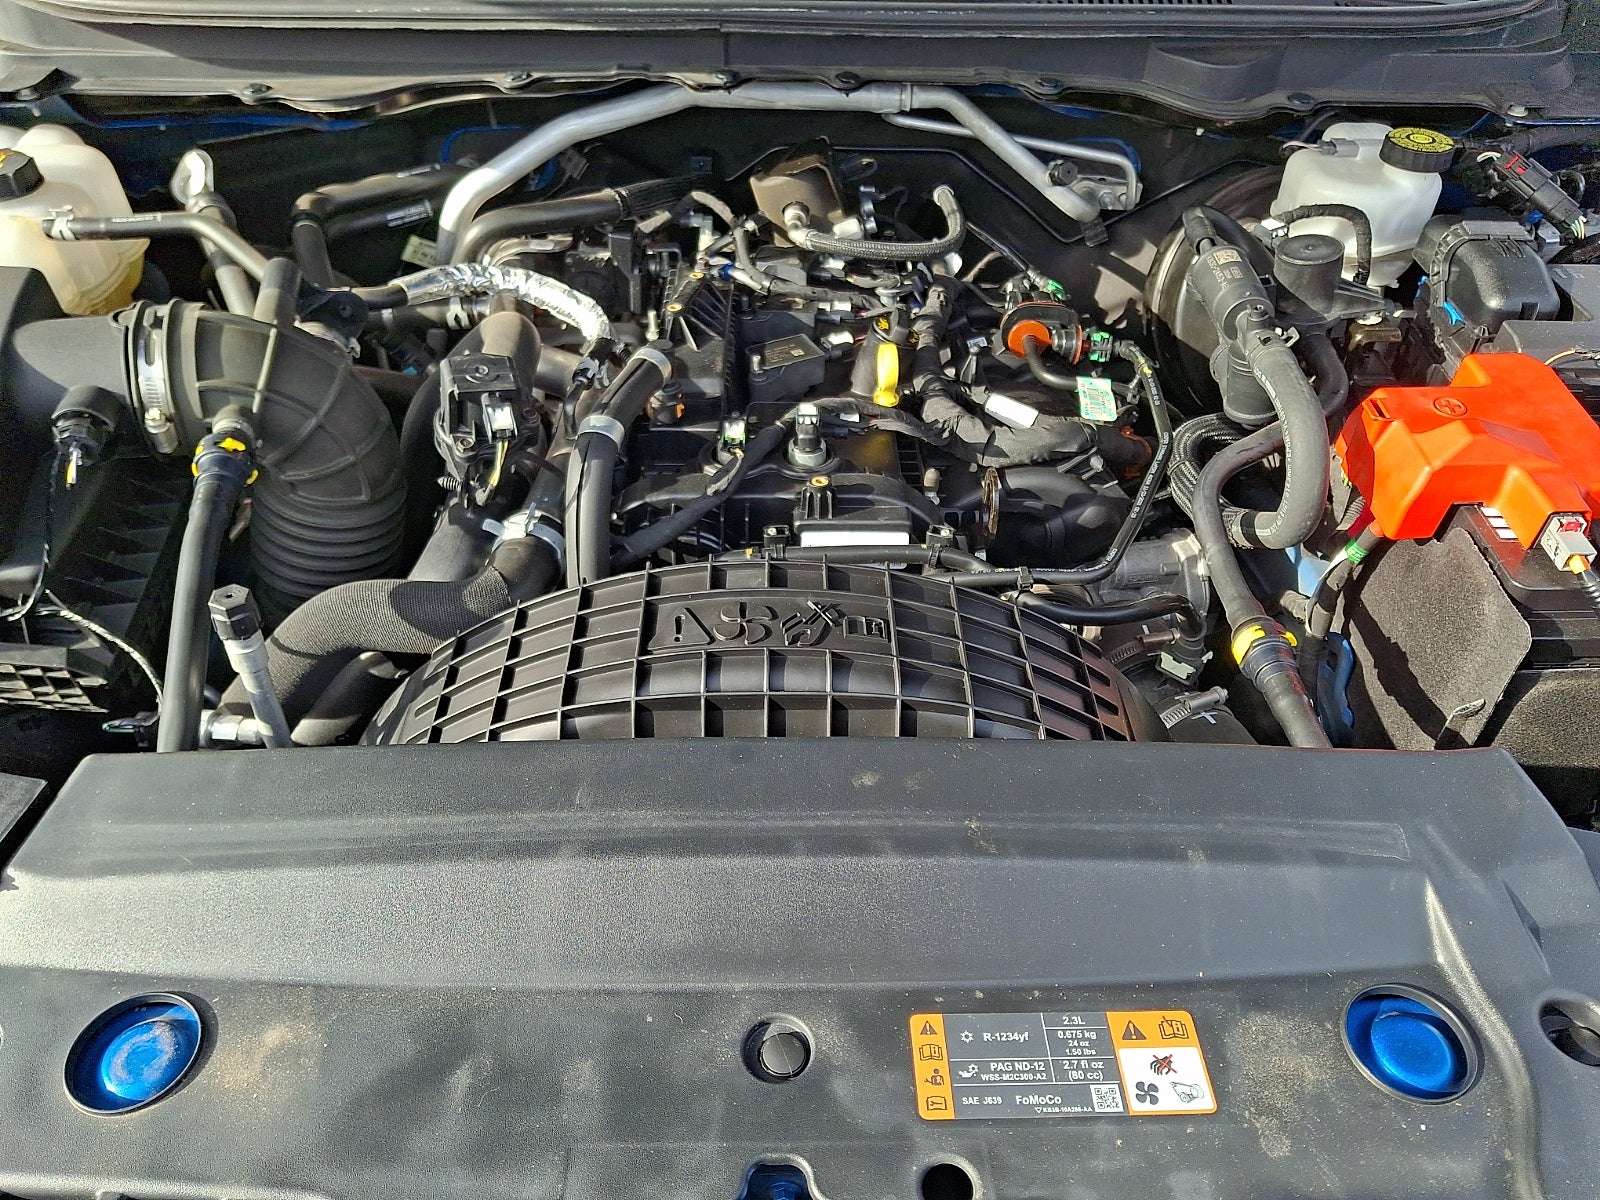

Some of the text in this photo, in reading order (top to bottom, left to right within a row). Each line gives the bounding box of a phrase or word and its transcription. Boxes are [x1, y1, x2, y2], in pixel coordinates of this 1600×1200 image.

[1062, 1016, 1086, 1025] 2.3L
[983, 1031, 1029, 1042] R-1234yf
[1057, 1030, 1097, 1040] 0.675 kg
[1065, 1048, 1082, 1056] 1.50
[990, 1061, 1046, 1072] PAG ND-12
[1062, 1060, 1105, 1069] 2.7 fl oz
[980, 1072, 1047, 1082] WSS-M2C300-A2
[1068, 1070, 1104, 1082] (80 cc)
[962, 1095, 1002, 1105] SAE J639
[1015, 1094, 1062, 1106] FoMoCo
